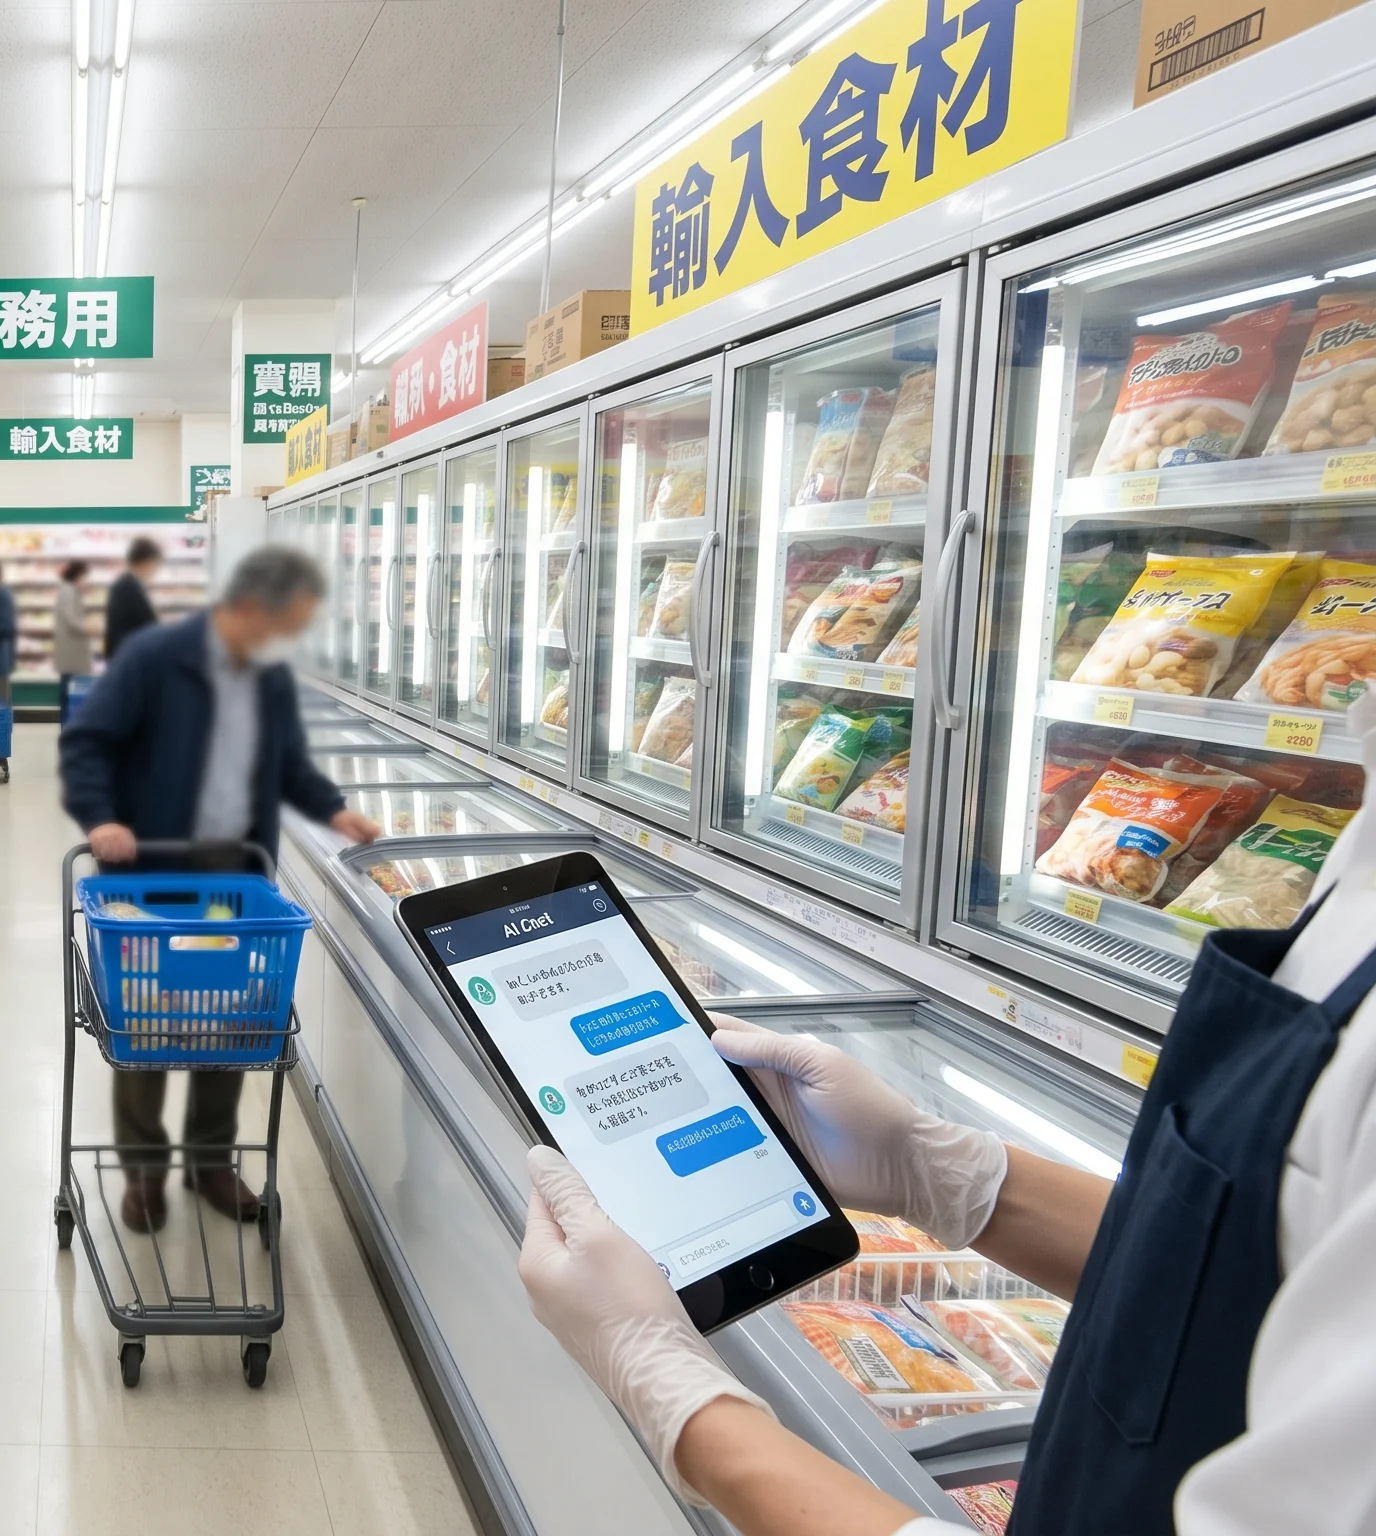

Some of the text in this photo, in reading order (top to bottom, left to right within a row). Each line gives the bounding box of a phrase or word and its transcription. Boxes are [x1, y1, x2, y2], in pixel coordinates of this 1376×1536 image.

[649, 0, 1023, 307] 輸入食材
[9, 426, 122, 453] 輸入食材
[504, 922, 521, 939] AI
